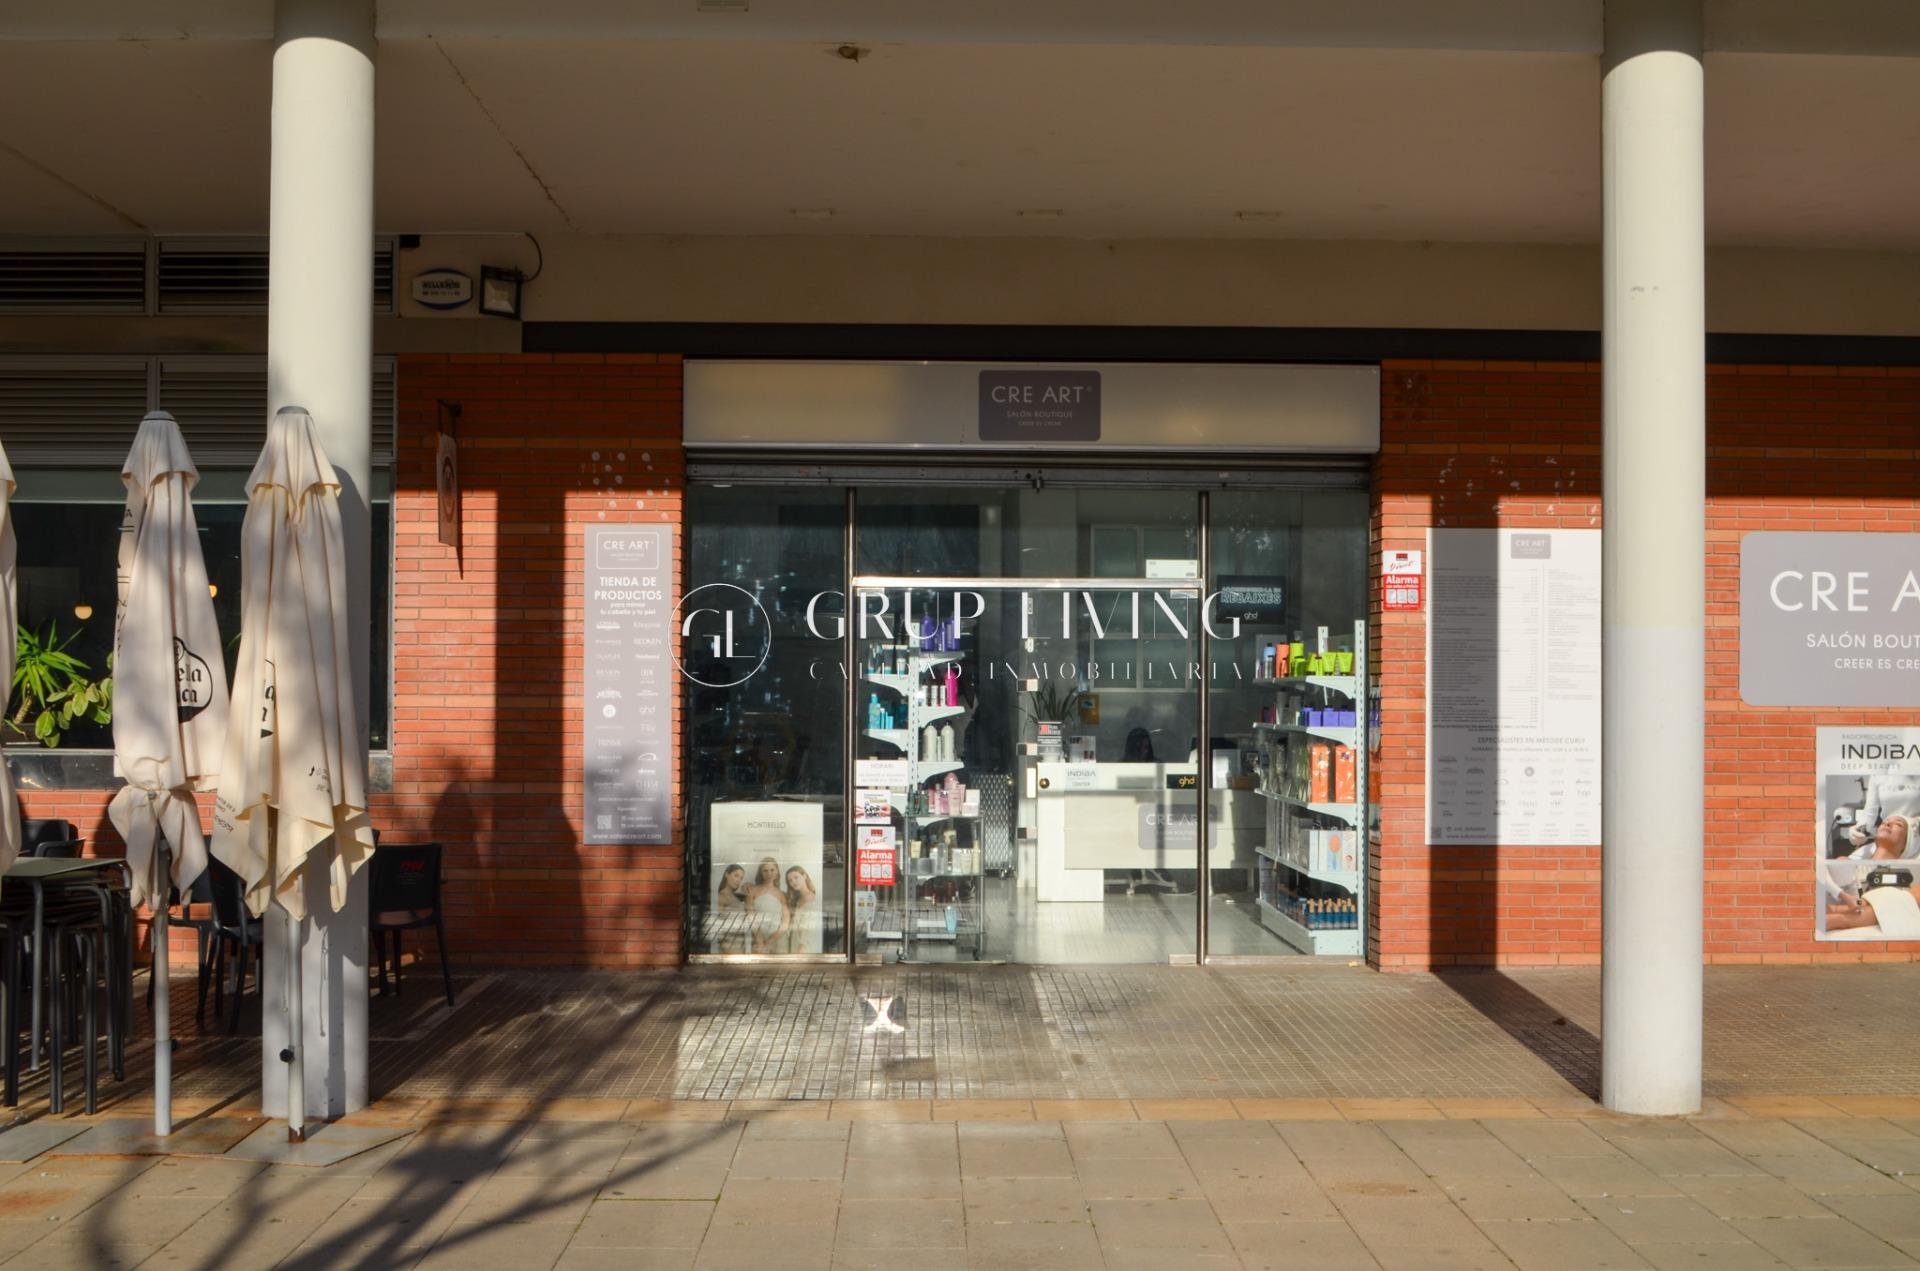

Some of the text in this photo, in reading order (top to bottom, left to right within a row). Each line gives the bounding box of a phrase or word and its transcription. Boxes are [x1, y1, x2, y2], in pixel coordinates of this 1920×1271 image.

[991, 385, 1084, 403] CRE ART
[1034, 410, 1073, 418] BOUTIQUE
[603, 540, 650, 550] CRE ART
[599, 576, 657, 587] TIENDA DE
[1385, 575, 1419, 585] Alarma
[594, 590, 662, 601] PRODUCTOS
[1770, 570, 1869, 612] CRE
[1243, 611, 1259, 620] ghd
[1807, 632, 1920, 649] SALÓN BOUT
[1834, 658, 1873, 669] CREER
[1878, 658, 1892, 669] ES
[1841, 743, 1920, 760] INDIBA
[1178, 775, 1196, 788] ghd
[1145, 813, 1198, 826] CRE AR
[860, 850, 893, 860] Alarma
